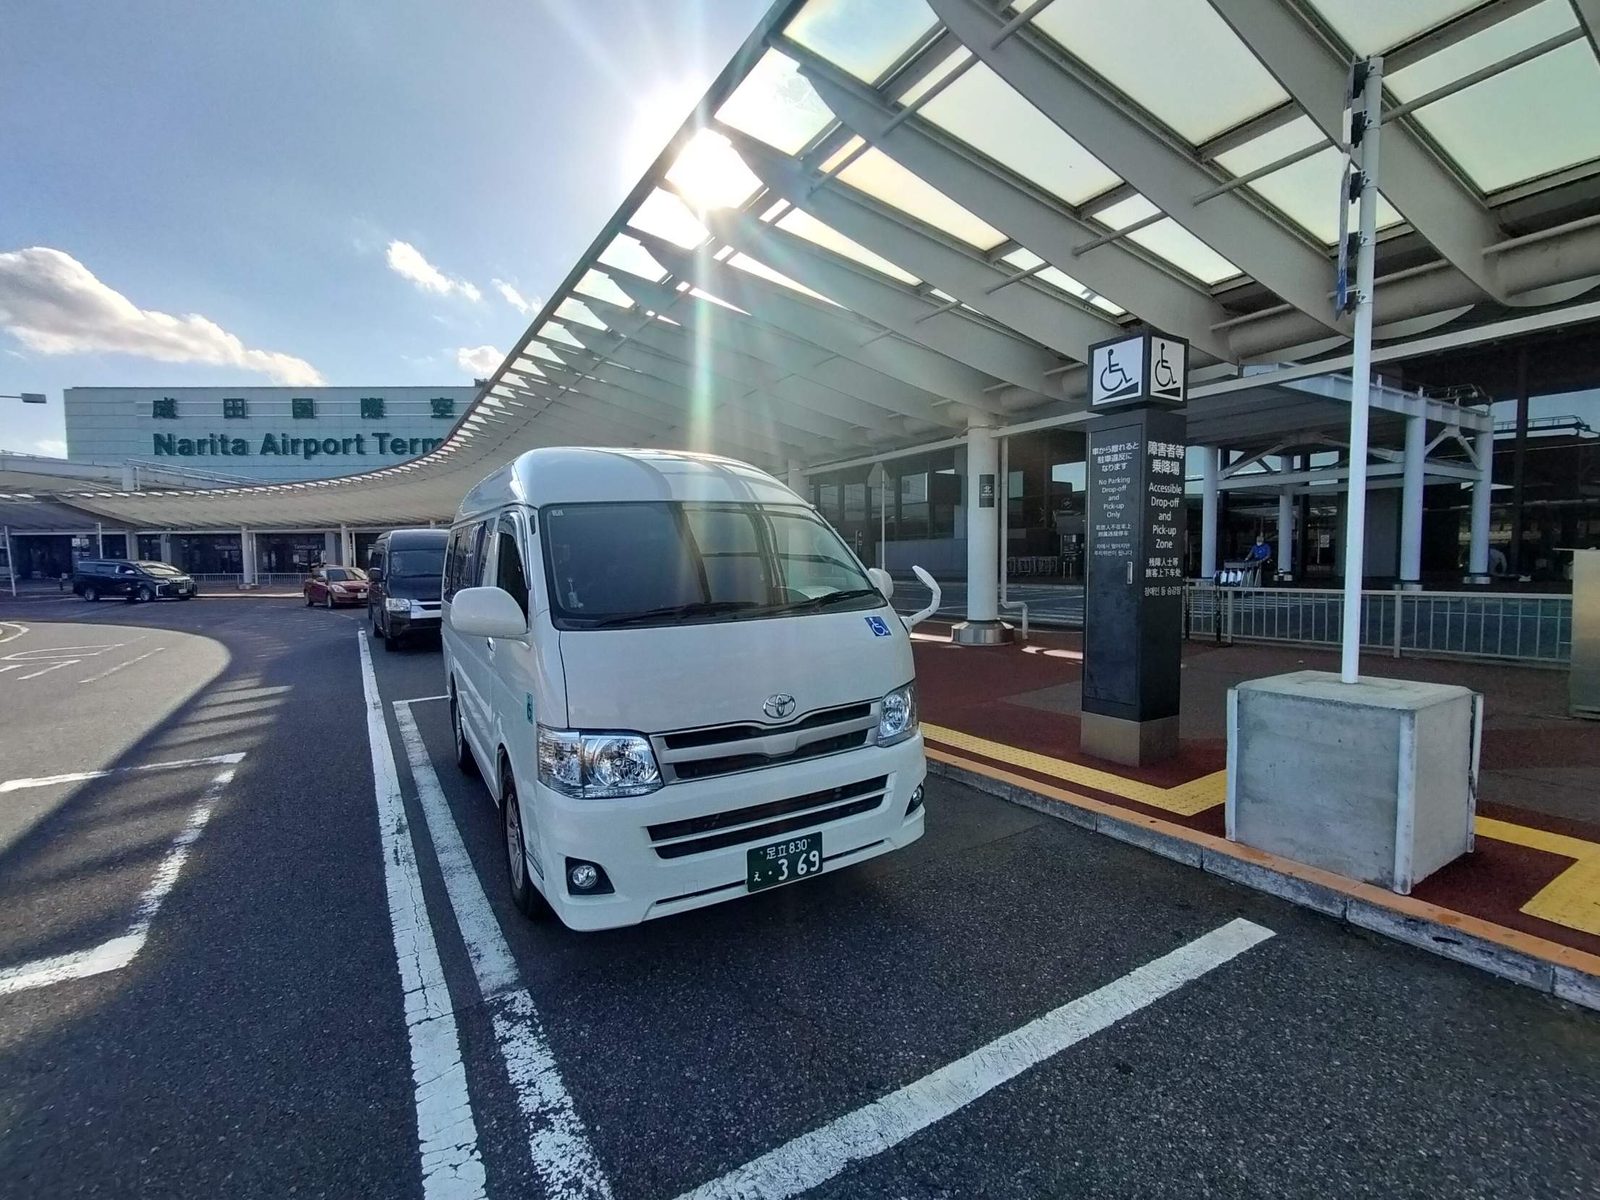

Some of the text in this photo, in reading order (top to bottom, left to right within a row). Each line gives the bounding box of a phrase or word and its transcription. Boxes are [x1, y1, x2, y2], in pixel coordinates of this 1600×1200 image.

[153, 433, 248, 456] Narita
[260, 432, 365, 459] Airport
[1147, 441, 1184, 459] 障害者等
[1101, 462, 1128, 472] なります
[1152, 459, 1180, 476] 乗降場
[1108, 476, 1131, 484] Parking
[1101, 485, 1127, 493] Drop-off
[1148, 482, 1182, 495] Accessible
[1103, 503, 1125, 511] Pick-up
[1151, 496, 1180, 508] Drop-off
[1106, 511, 1121, 519] Only
[1158, 511, 1172, 521] and
[1152, 524, 1177, 537] Pick-up
[1155, 538, 1173, 549] Zone
[766, 838, 808, 860] 足立 830
